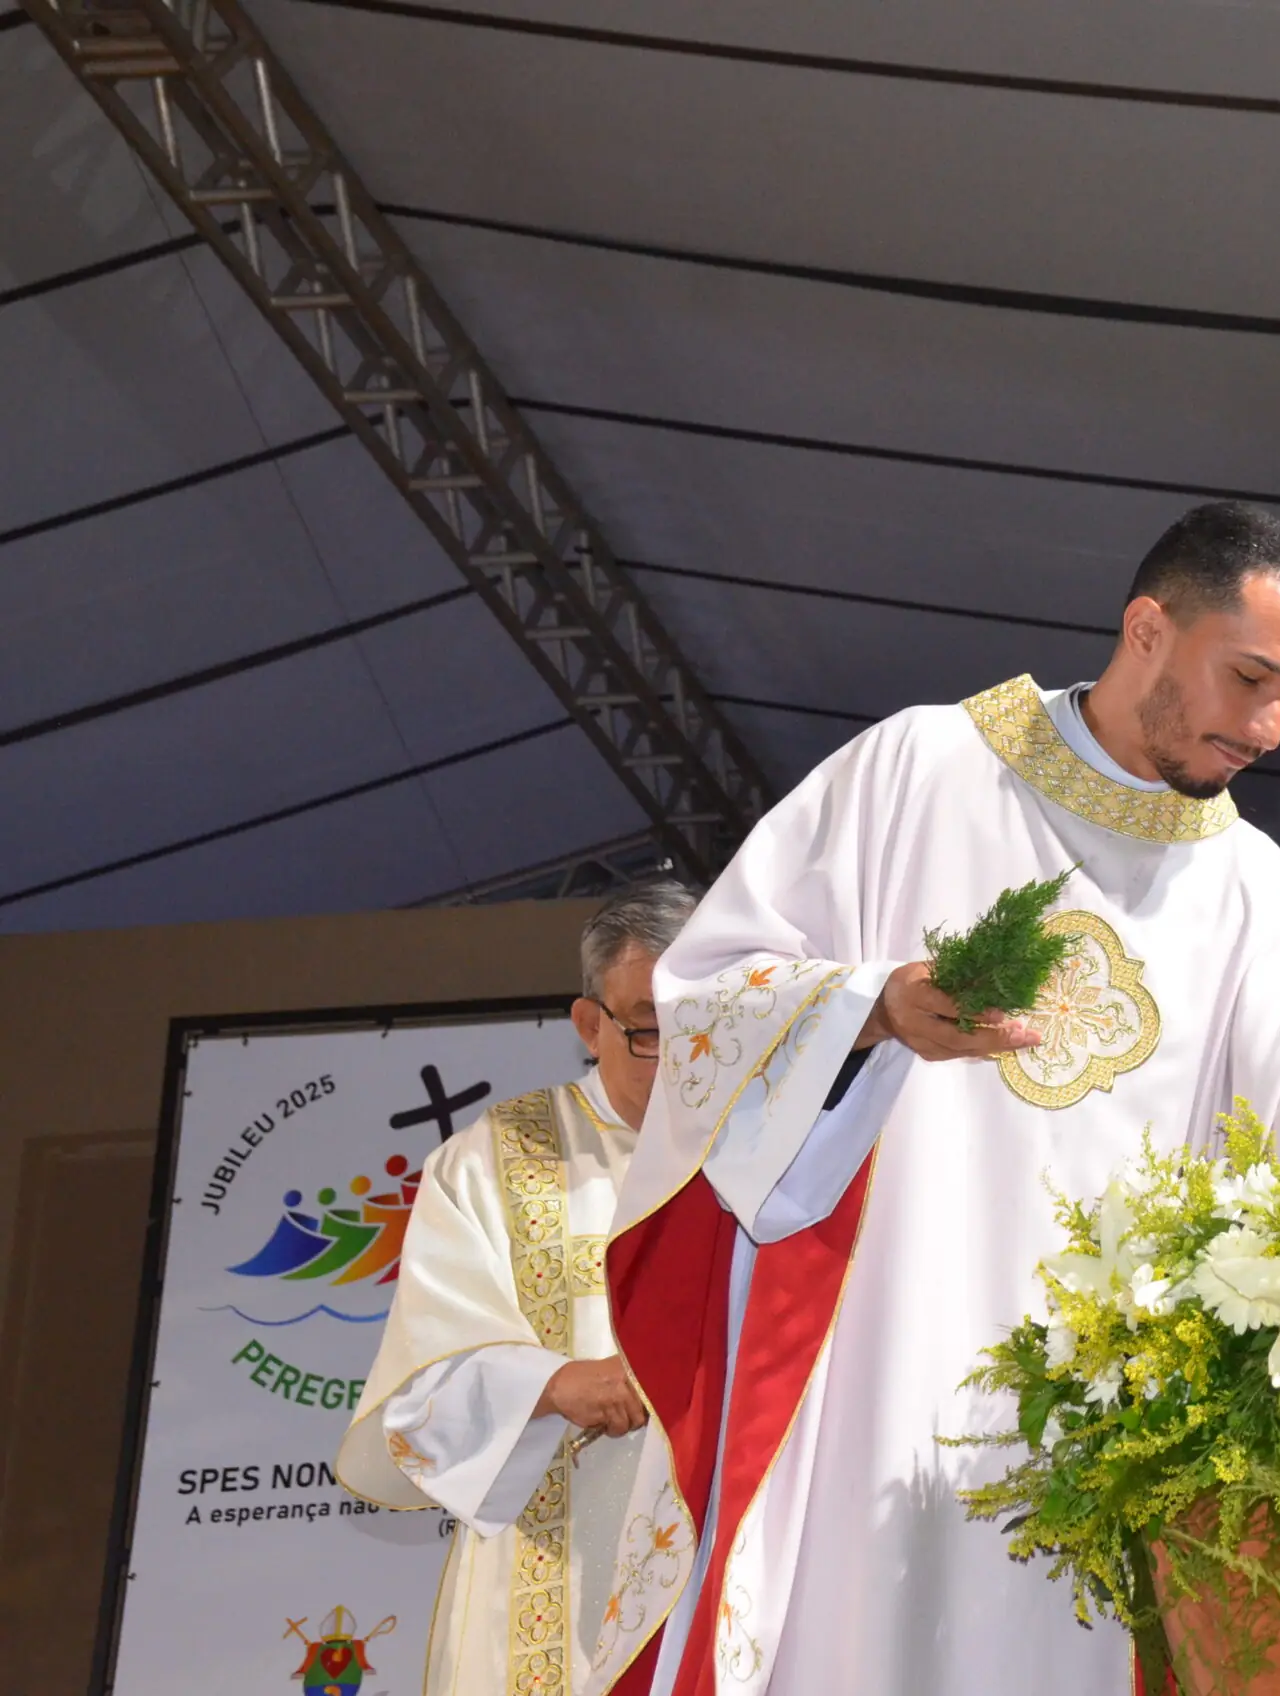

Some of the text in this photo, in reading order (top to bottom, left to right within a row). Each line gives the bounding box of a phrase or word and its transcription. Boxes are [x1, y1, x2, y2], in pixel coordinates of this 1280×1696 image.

[201, 1074, 336, 1216] JUBILEU 2025
[178, 1466, 260, 1494] SPES
[186, 1506, 201, 1525] A
[210, 1500, 330, 1527] esperança
